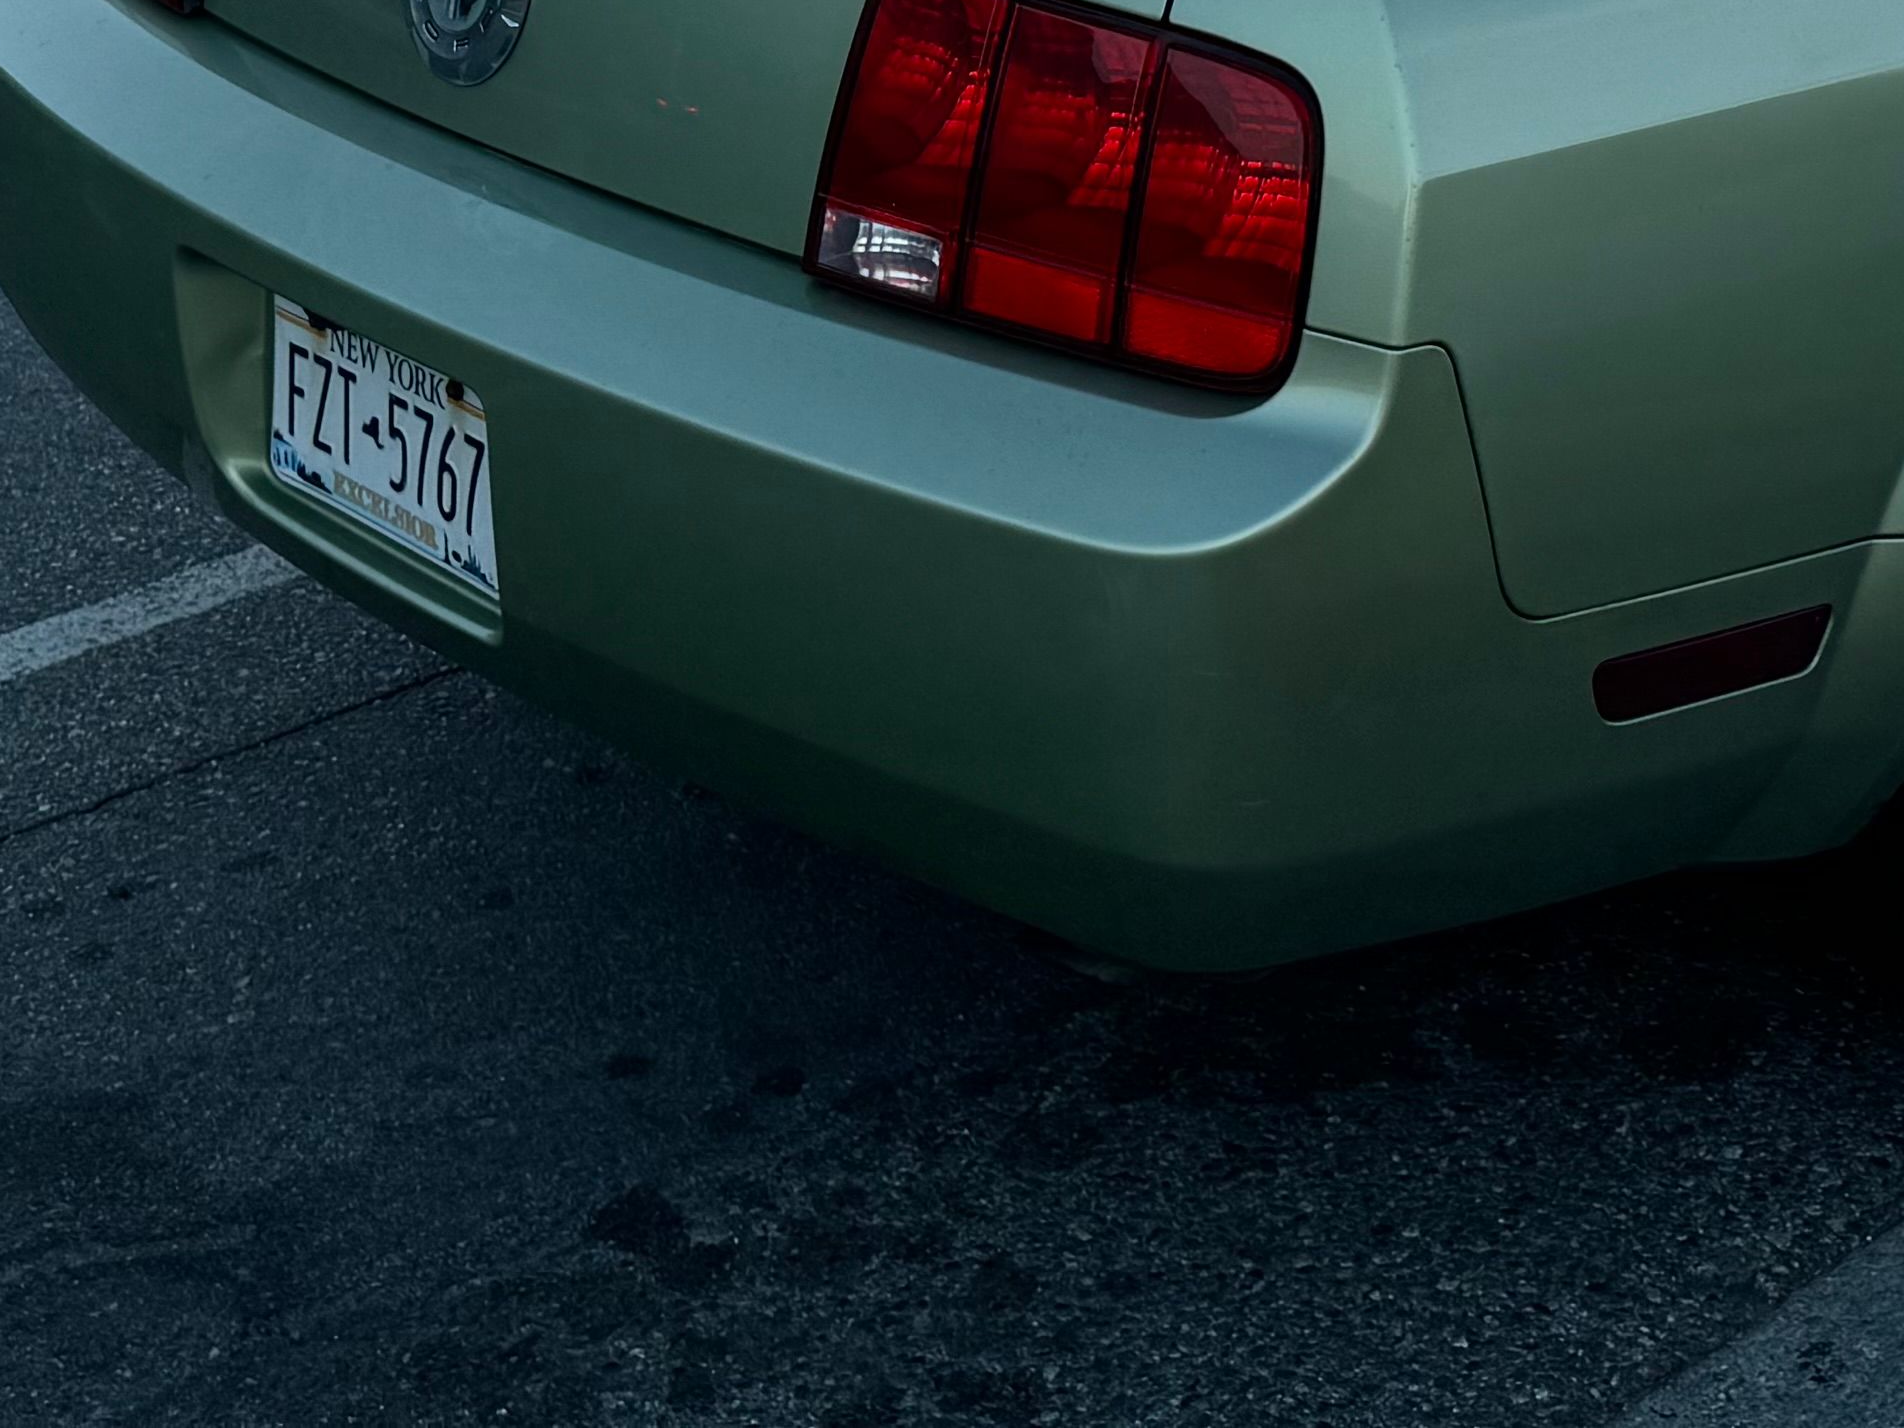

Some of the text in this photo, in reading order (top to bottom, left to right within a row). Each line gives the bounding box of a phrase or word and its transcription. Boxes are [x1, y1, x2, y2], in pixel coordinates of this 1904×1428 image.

[330, 329, 446, 410] NEW YORK
[288, 341, 486, 537] FZT 5767
[332, 469, 439, 551] EXCELSIOR
